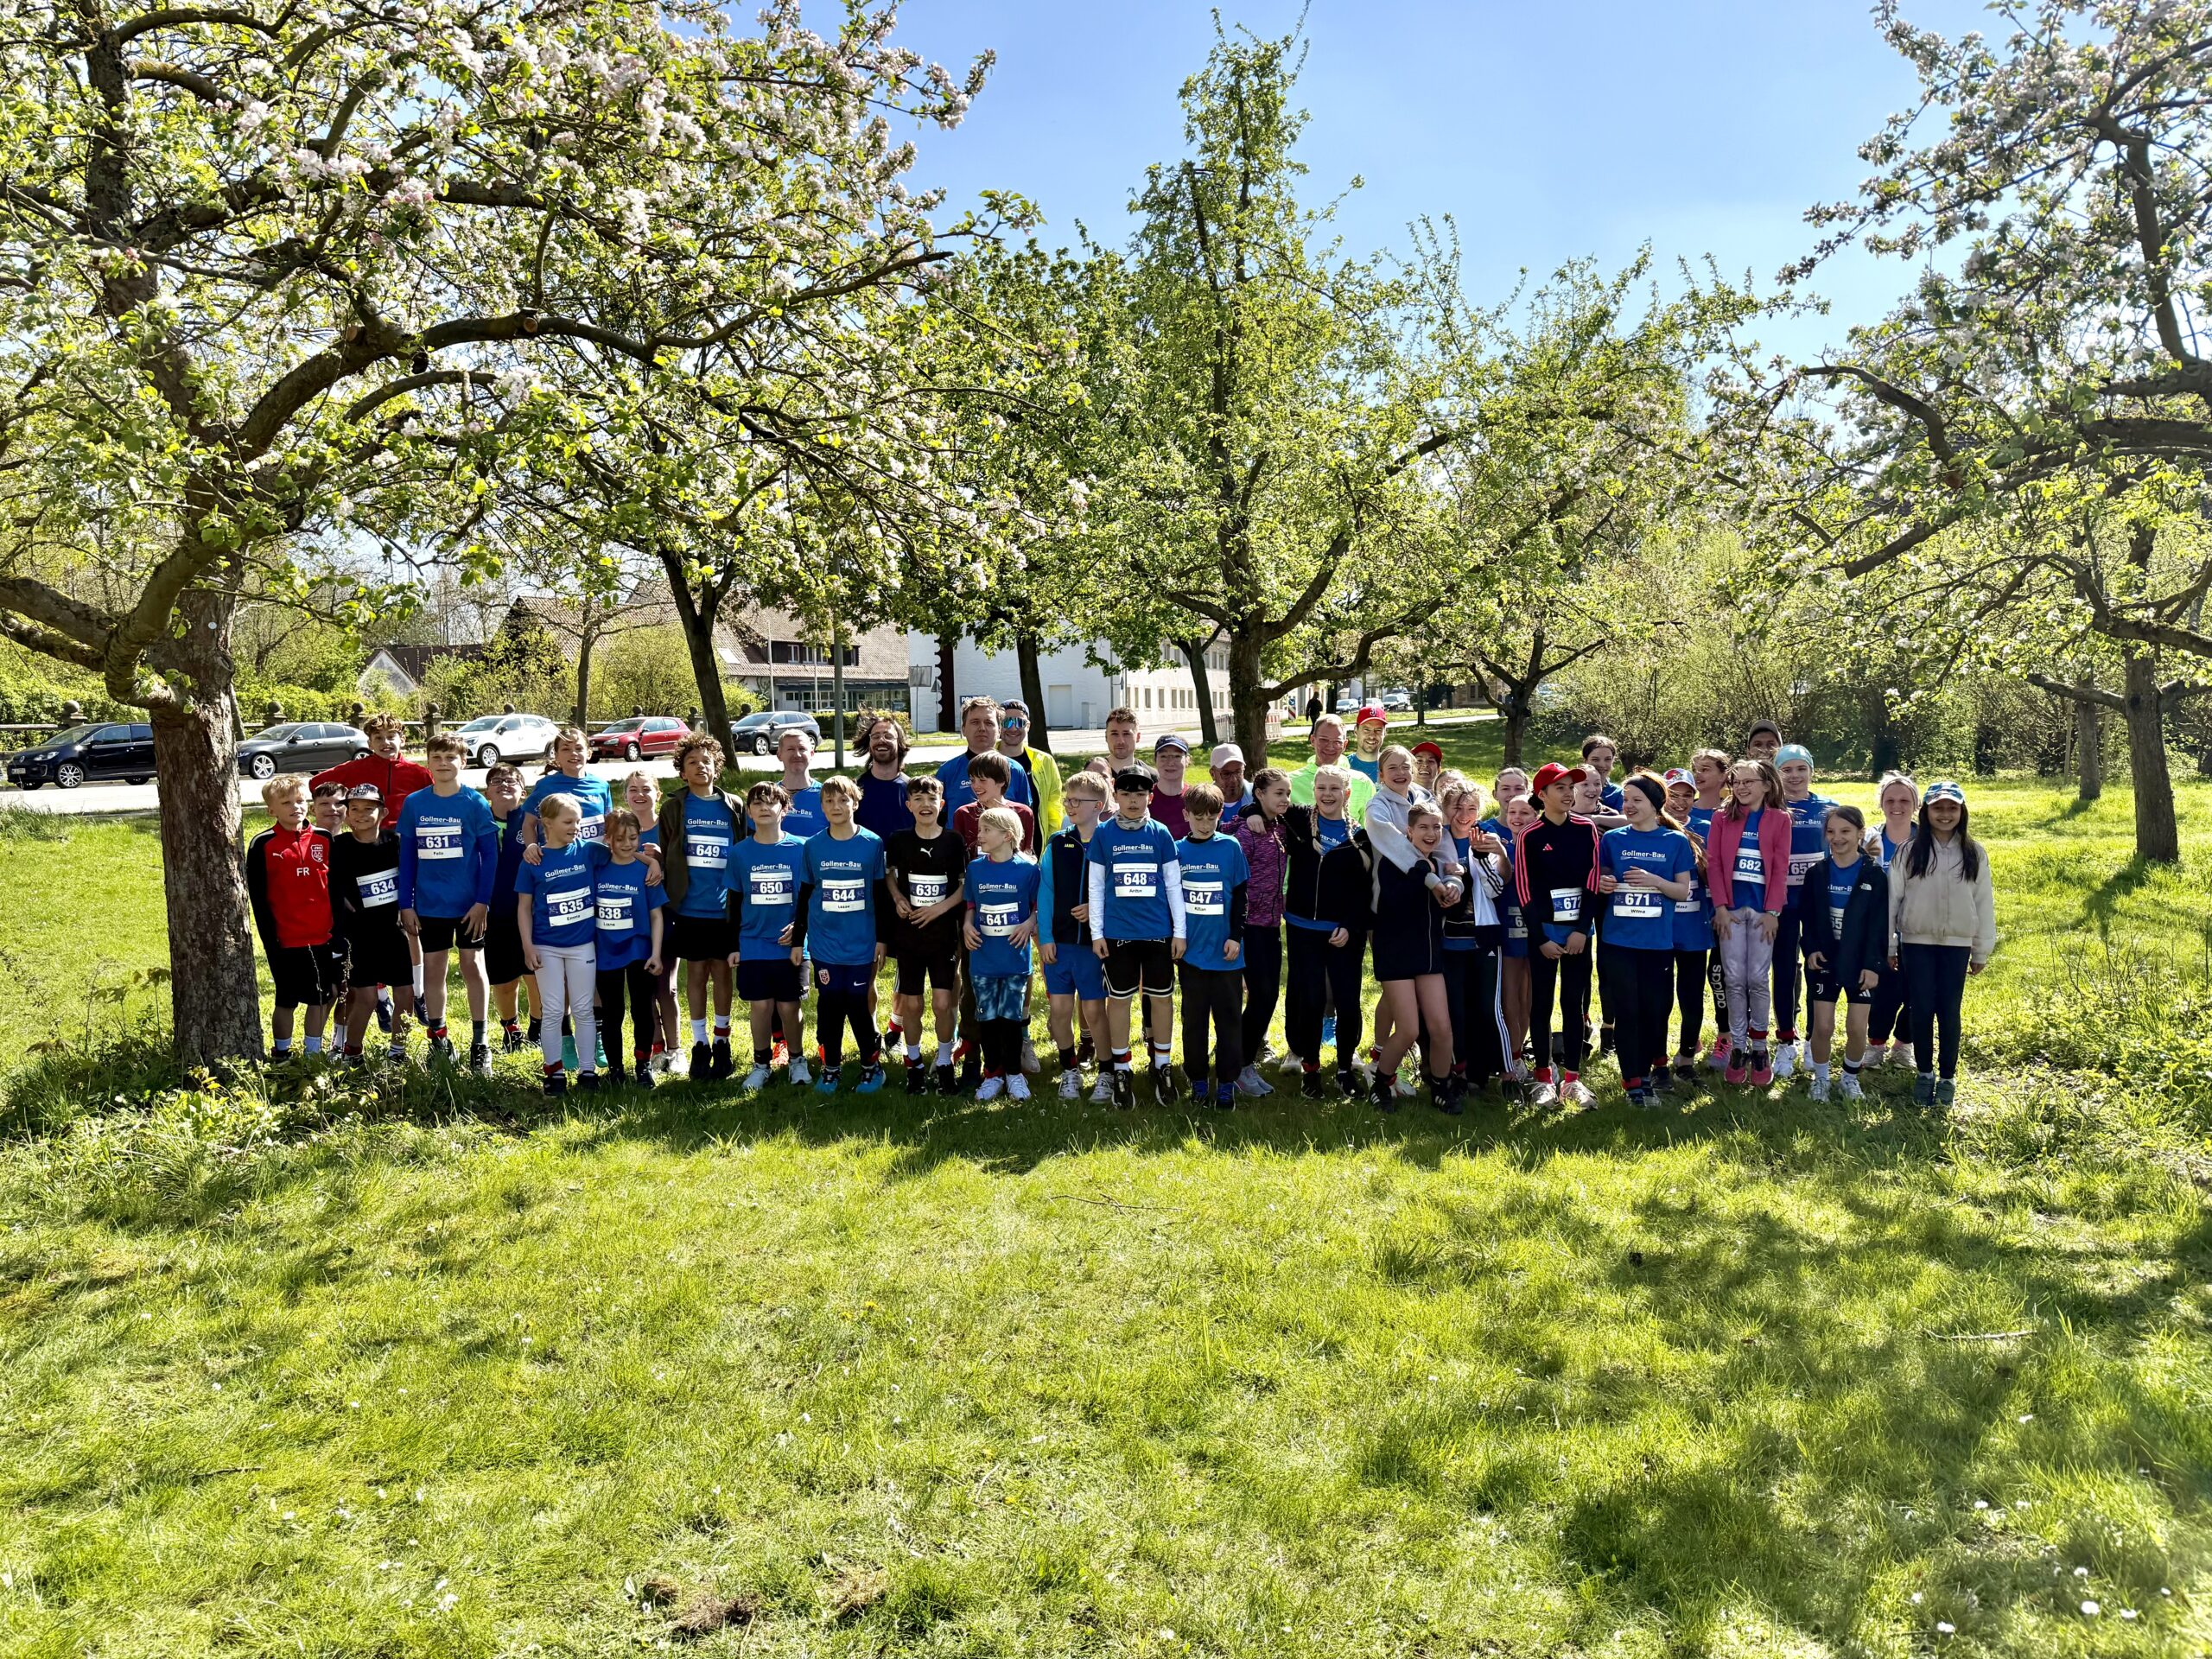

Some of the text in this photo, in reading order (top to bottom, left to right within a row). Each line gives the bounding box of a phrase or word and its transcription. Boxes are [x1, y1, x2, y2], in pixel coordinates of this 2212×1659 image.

[426, 836, 449, 849] 631
[696, 844, 720, 858] 649
[1621, 850, 1666, 859] Gollmer-Bau
[1738, 859, 1762, 872] 682
[296, 868, 310, 877] FR
[1123, 873, 1147, 886] 648
[371, 879, 395, 895] 634
[598, 883, 638, 892] Gollmer-Bau
[760, 881, 783, 894] 650
[916, 884, 939, 896] 639
[832, 889, 855, 901] 644
[1189, 892, 1212, 904] 647
[1624, 893, 1650, 906] 671
[559, 899, 584, 914] 635
[599, 906, 622, 919] 638
[986, 913, 1007, 925] 641
[1712, 964, 1726, 1008] adidas
